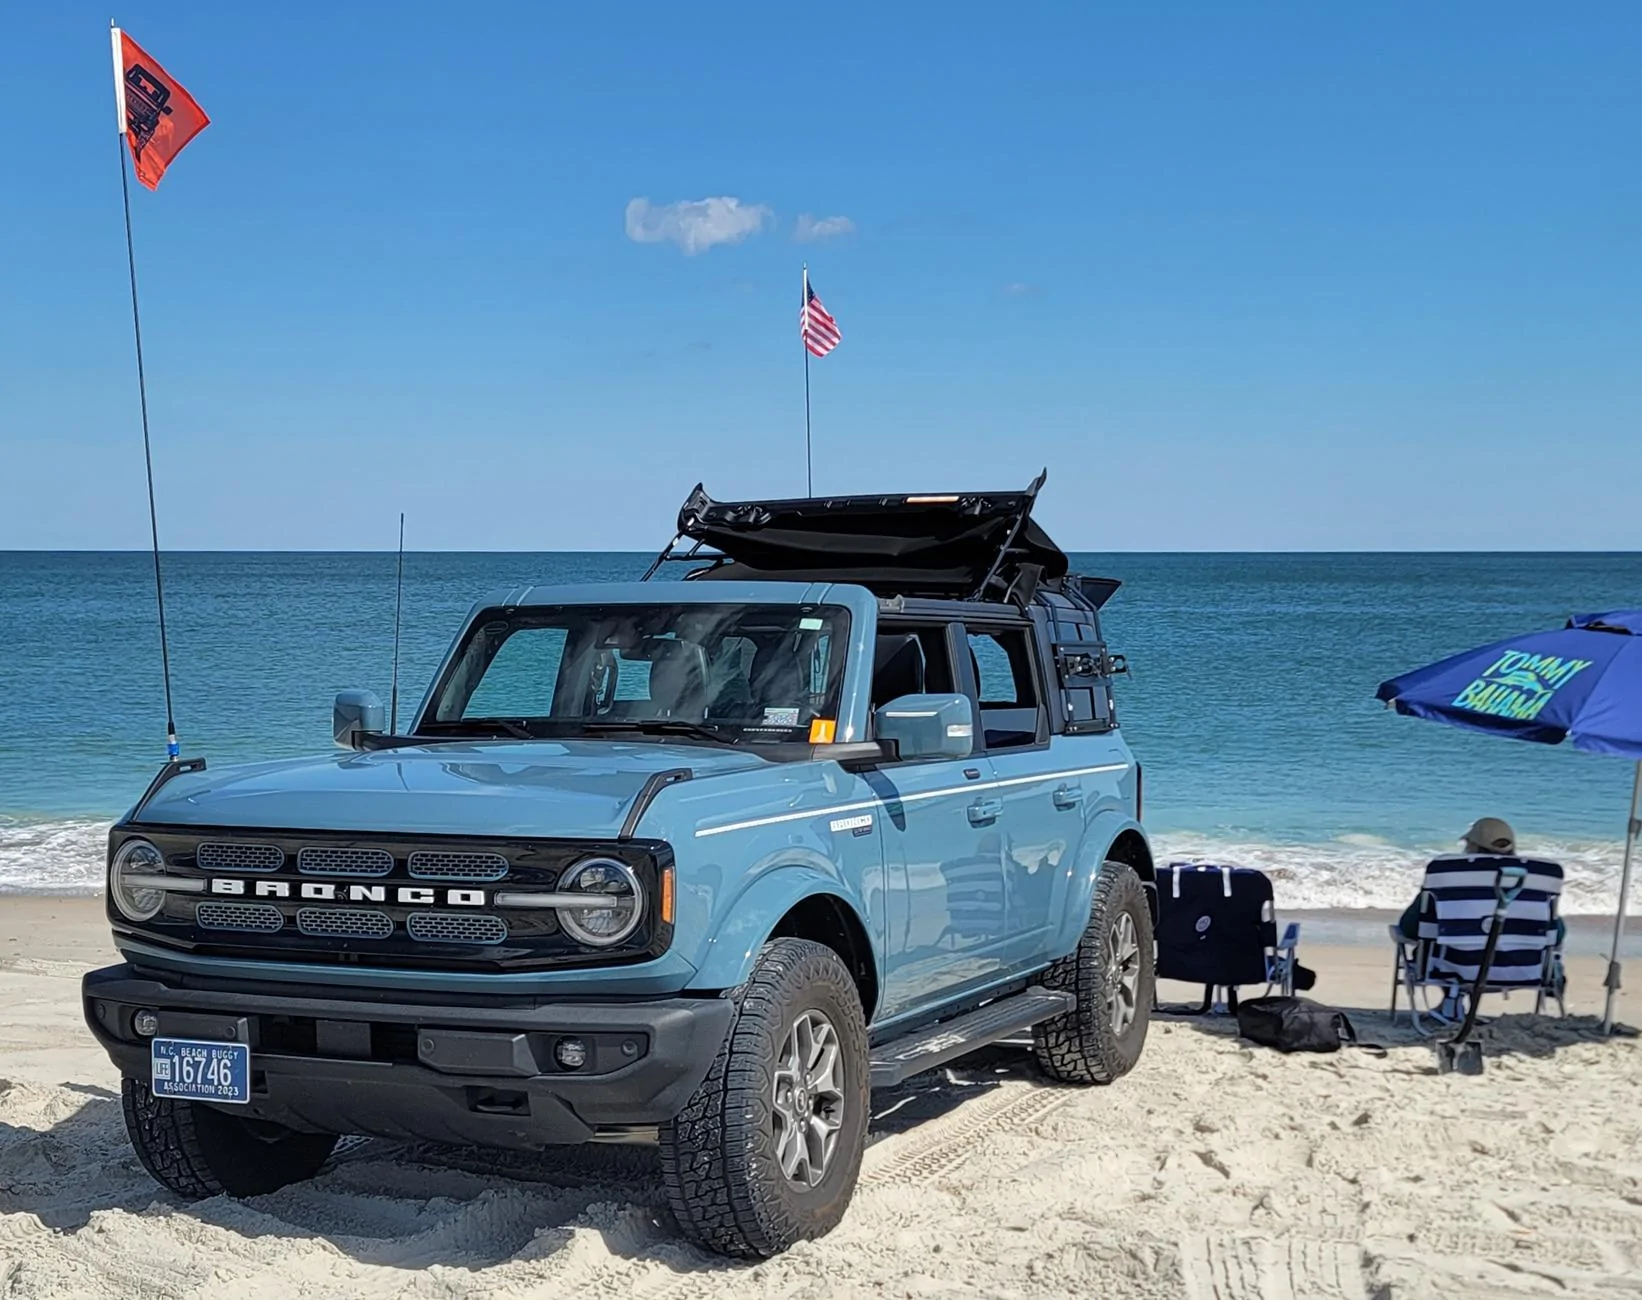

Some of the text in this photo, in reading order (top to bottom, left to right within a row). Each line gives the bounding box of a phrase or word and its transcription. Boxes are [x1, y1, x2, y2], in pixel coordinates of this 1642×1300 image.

[1481, 649, 1594, 690] TOMMY
[1450, 677, 1554, 720] BAHAMA
[211, 878, 486, 906] BRONCO
[160, 1046, 239, 1060] N.C. BEACH BUGGY
[172, 1055, 232, 1086] 16746
[163, 1081, 239, 1096] ASSOCIATION 2023
